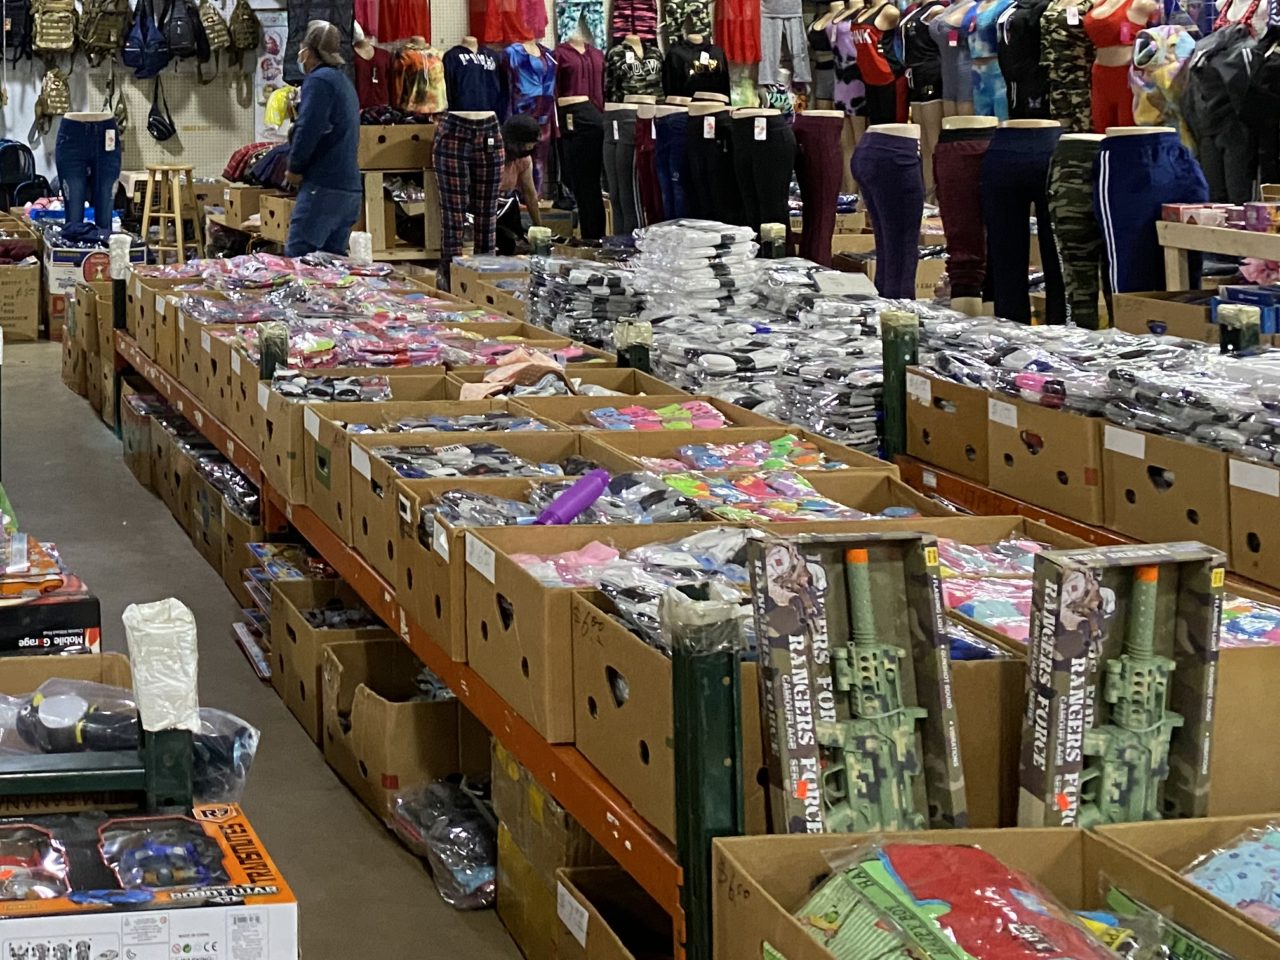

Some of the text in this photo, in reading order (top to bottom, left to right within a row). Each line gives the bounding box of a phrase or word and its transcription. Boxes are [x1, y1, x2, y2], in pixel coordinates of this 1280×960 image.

[442, 445, 460, 453] USA
[53, 635, 83, 646] Mobile
[816, 675, 837, 723] FOR
[1032, 578, 1058, 772] RANGERS FORCE
[781, 674, 798, 750] CAMOUFLAGE
[788, 634, 824, 834] RANGERS FORCE
[1062, 657, 1087, 827] RANGERS FORC
[170, 889, 229, 900] ROBOT
